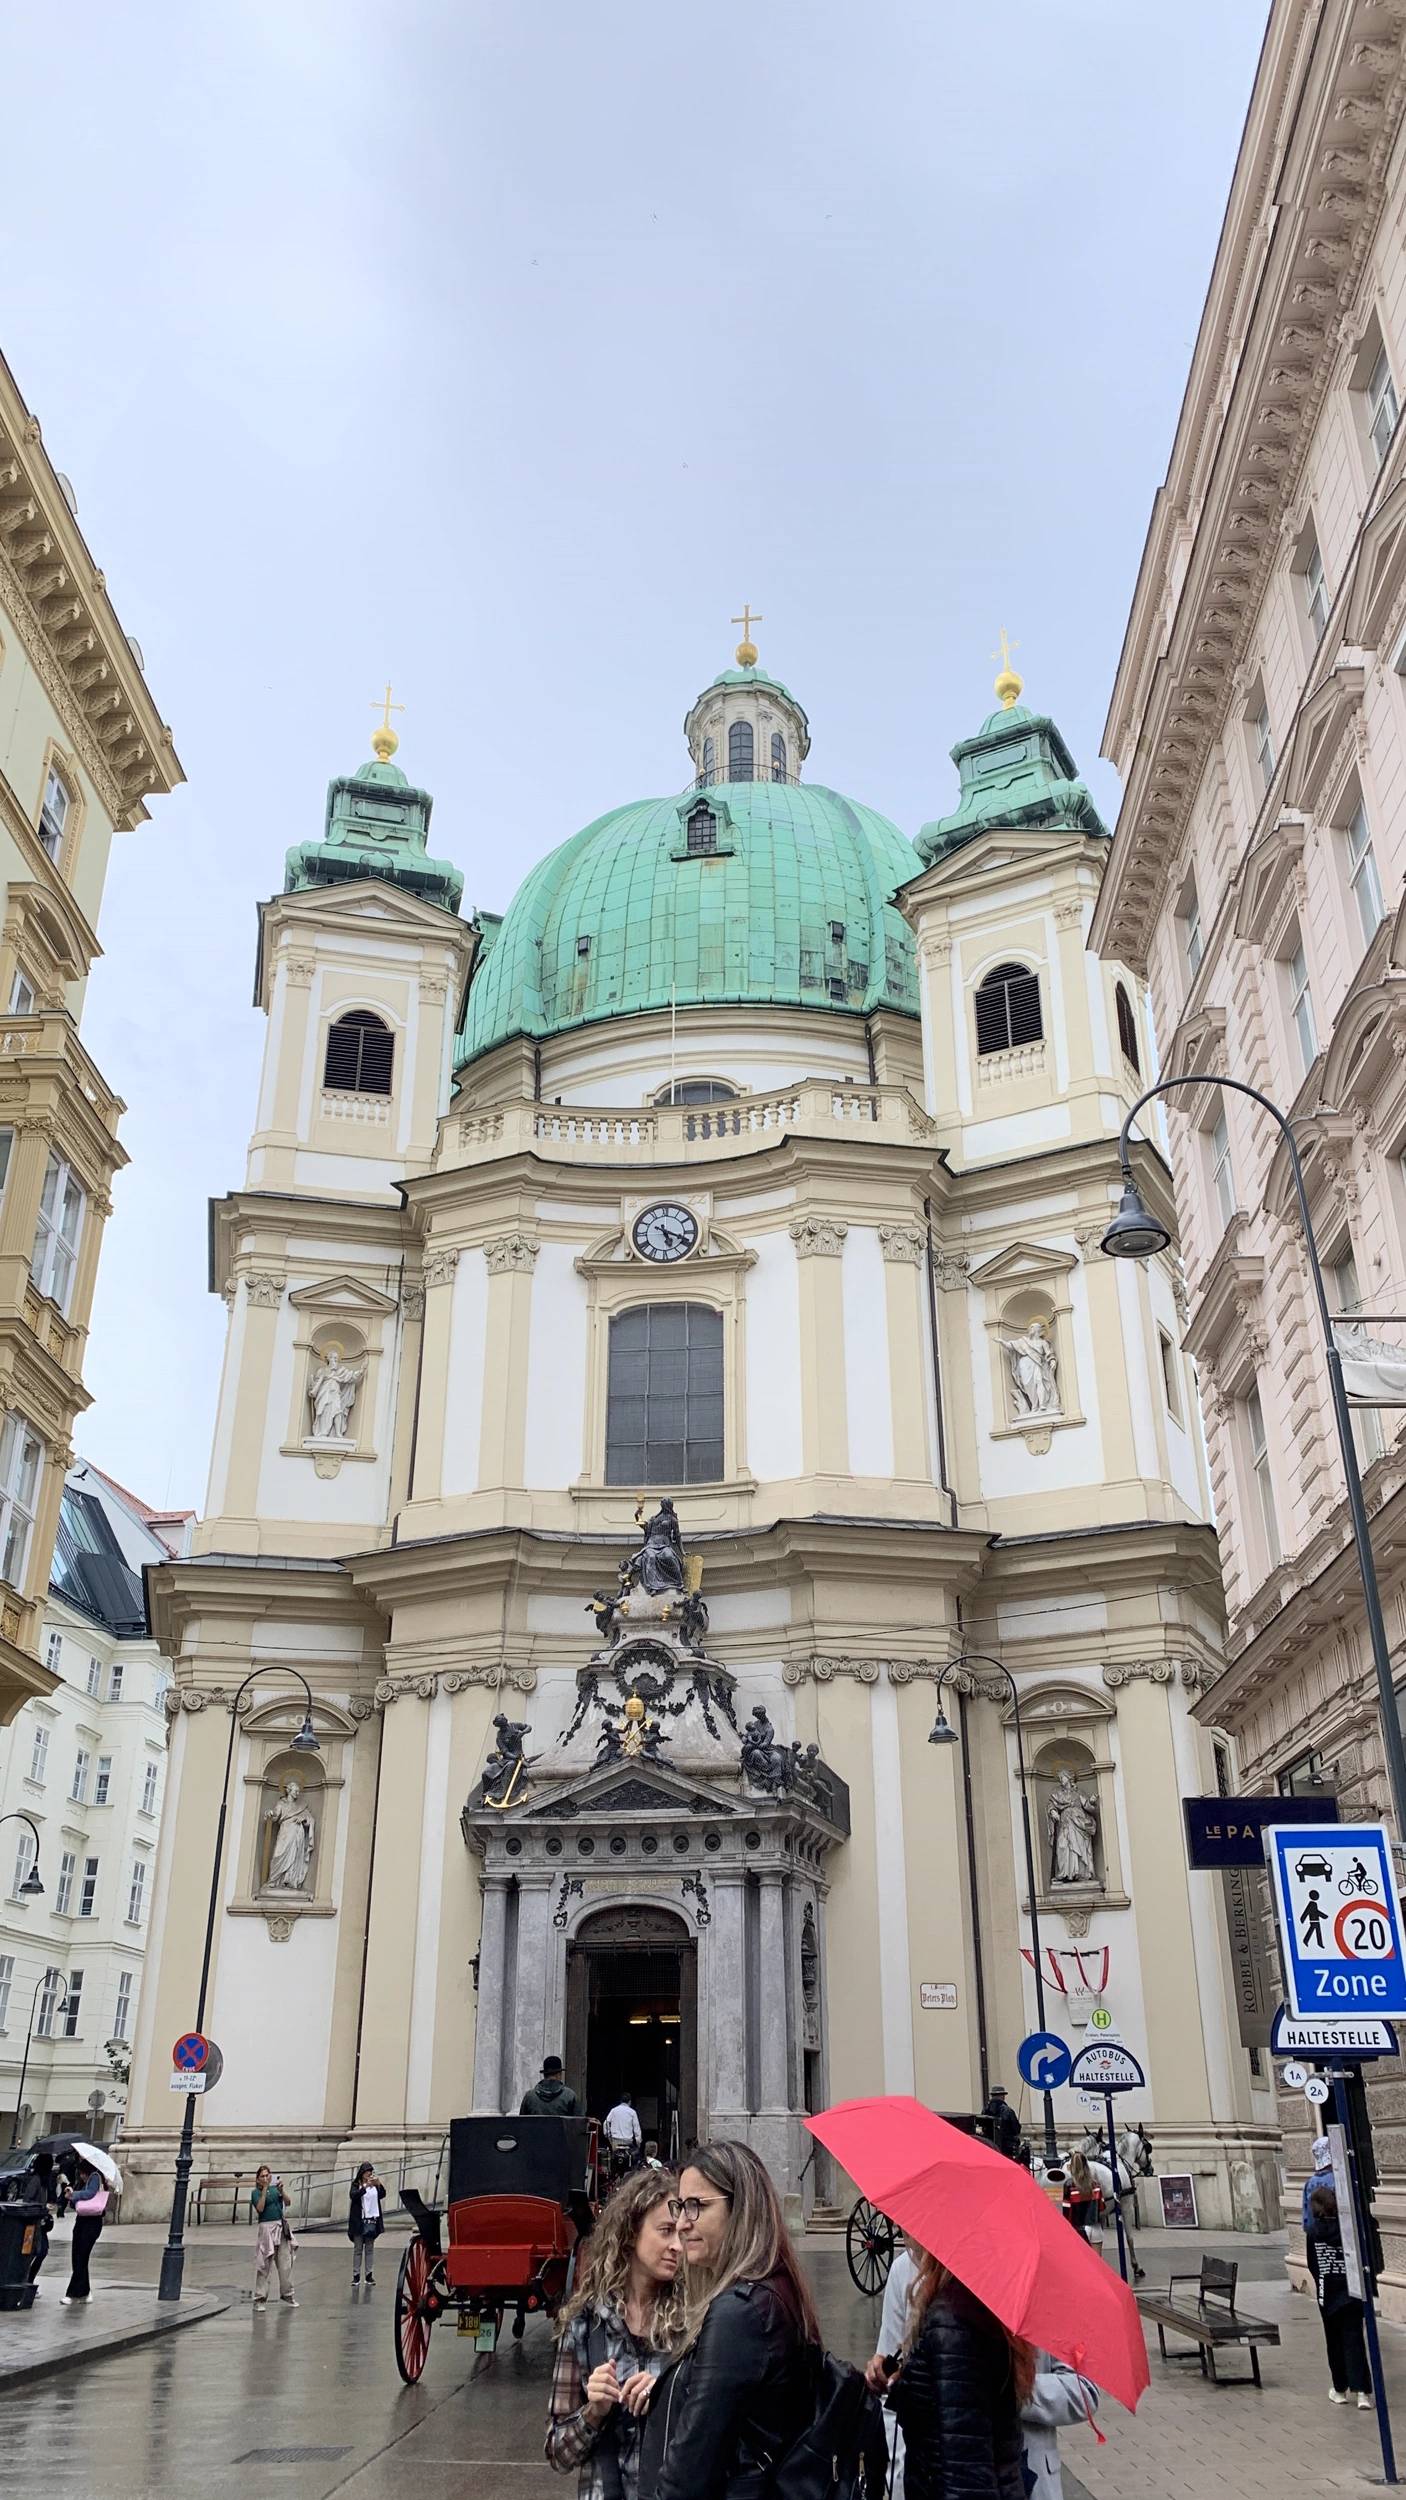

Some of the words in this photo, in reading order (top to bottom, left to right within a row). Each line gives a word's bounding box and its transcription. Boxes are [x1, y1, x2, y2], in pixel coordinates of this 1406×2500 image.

[1205, 1826, 1221, 1835] LE
[1351, 1919, 1386, 1950] 20
[1239, 1944, 1249, 1954] &
[1240, 1960, 1256, 2013] ROBBE
[1314, 1969, 1387, 1997] Zone
[1097, 2013, 1107, 2026] H
[1287, 2031, 1381, 2045] HALTESTELLE
[1085, 2049, 1126, 2065] AUTOBUS
[1079, 2072, 1135, 2082] HALTESTELLE
[1290, 2070, 1302, 2081] 1A
[1310, 2086, 1324, 2097] 2A
